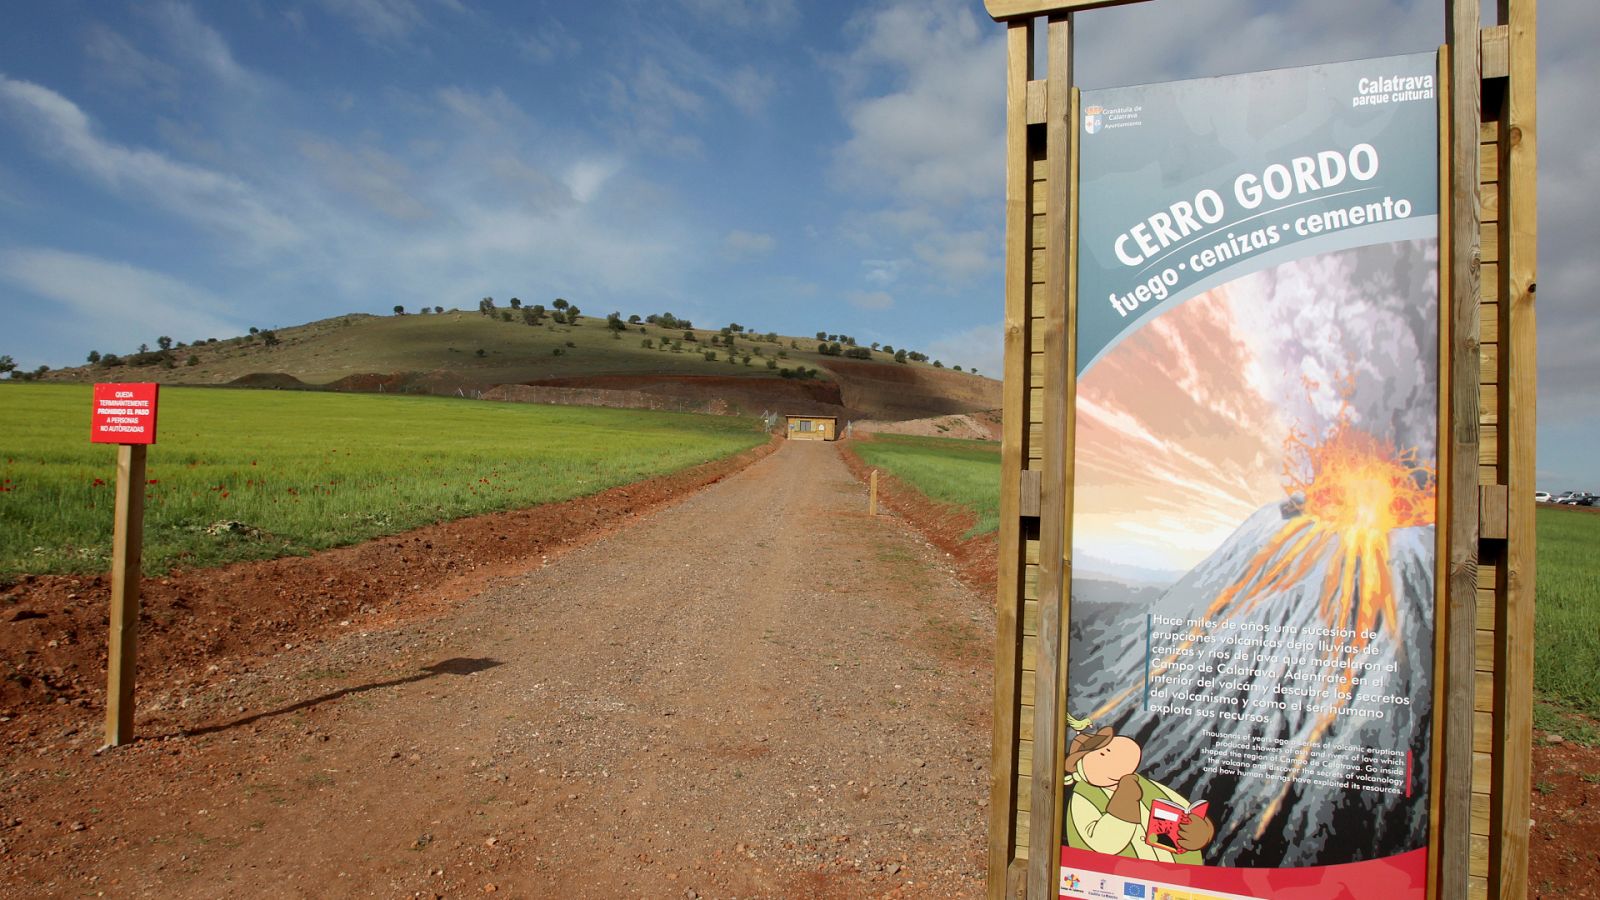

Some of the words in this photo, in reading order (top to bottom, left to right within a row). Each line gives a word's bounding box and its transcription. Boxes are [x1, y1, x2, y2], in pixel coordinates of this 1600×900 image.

[1352, 92, 1389, 107] parque
[1391, 89, 1434, 103] cultural
[1358, 74, 1433, 95] Calatrava
[1114, 189, 1224, 266] CERRO
[1233, 143, 1379, 209] GORDO
[1108, 266, 1179, 318] fuego
[1189, 231, 1281, 273] cenizas
[1294, 196, 1412, 235] cemento
[1152, 614, 1183, 626] Hace
[1186, 617, 1218, 629] miles
[1221, 618, 1237, 630] de
[1240, 619, 1271, 633] años
[1274, 625, 1298, 634] una
[1302, 625, 1356, 638] sucesión
[1360, 628, 1377, 640] de
[1152, 629, 1216, 644] erupciones
[1318, 640, 1360, 654] lluvias
[1363, 644, 1380, 656] de
[1151, 643, 1195, 657] cenizas
[1198, 649, 1205, 659] y
[1233, 649, 1250, 662] de
[1253, 654, 1279, 663] lava
[1282, 656, 1307, 668] que
[1310, 657, 1382, 671] modelaron
[1385, 661, 1399, 673] el
[1151, 657, 1195, 674] Campo
[1198, 661, 1214, 674] de
[1217, 663, 1282, 679] Calatrava.
[1351, 676, 1369, 685] en
[1371, 676, 1385, 688] el
[1150, 672, 1194, 686] interior
[1196, 676, 1216, 689] del
[1219, 680, 1260, 692] volcán
[1262, 685, 1270, 695] y
[1272, 682, 1331, 699] descubre
[1333, 688, 1353, 701] los
[1356, 693, 1410, 705] secretos
[1150, 687, 1169, 699] del
[1171, 690, 1239, 705] volcanismo
[1241, 699, 1250, 709] y
[1290, 700, 1303, 709] el
[1306, 704, 1327, 714] ser
[1329, 704, 1384, 718] humano
[1149, 702, 1193, 717] explota
[1195, 709, 1216, 718] sus
[1218, 711, 1274, 724] recursos.
[1201, 729, 1241, 739] Thousands
[1242, 733, 1252, 741] of
[1252, 736, 1273, 744] years
[1274, 737, 1290, 746] ago
[1322, 741, 1332, 750] of
[1332, 744, 1366, 753] volcanic
[1366, 747, 1406, 757] eruptions
[1215, 740, 1251, 750] produced
[1251, 743, 1283, 753] showers
[1294, 747, 1309, 756] ash
[1310, 750, 1327, 758] and
[1327, 751, 1350, 760] rivers
[1351, 754, 1361, 762] of
[1361, 755, 1380, 764] lava
[1380, 757, 1405, 766] which
[1200, 746, 1228, 757] shaped
[1228, 750, 1242, 758] the
[1243, 752, 1269, 761] region
[1269, 754, 1279, 762] of
[1279, 755, 1308, 766] Campo
[1309, 758, 1321, 767] de
[1322, 760, 1363, 771] Calatrava.
[1365, 764, 1379, 773] Go
[1379, 766, 1405, 776] inside
[1207, 756, 1221, 764] the
[1221, 758, 1251, 768] volcano
[1251, 761, 1268, 770] and
[1268, 763, 1301, 774] discover
[1301, 767, 1316, 775] the
[1316, 770, 1344, 779] secrets
[1344, 771, 1355, 780] of
[1355, 773, 1404, 786] volcanology
[1202, 765, 1219, 773] and
[1219, 766, 1237, 776] how
[1236, 769, 1264, 779] human
[1264, 771, 1292, 783] beings
[1292, 775, 1313, 784] have
[1312, 778, 1350, 789] exploited
[1351, 781, 1361, 790] its
[1362, 784, 1403, 794] resources.
